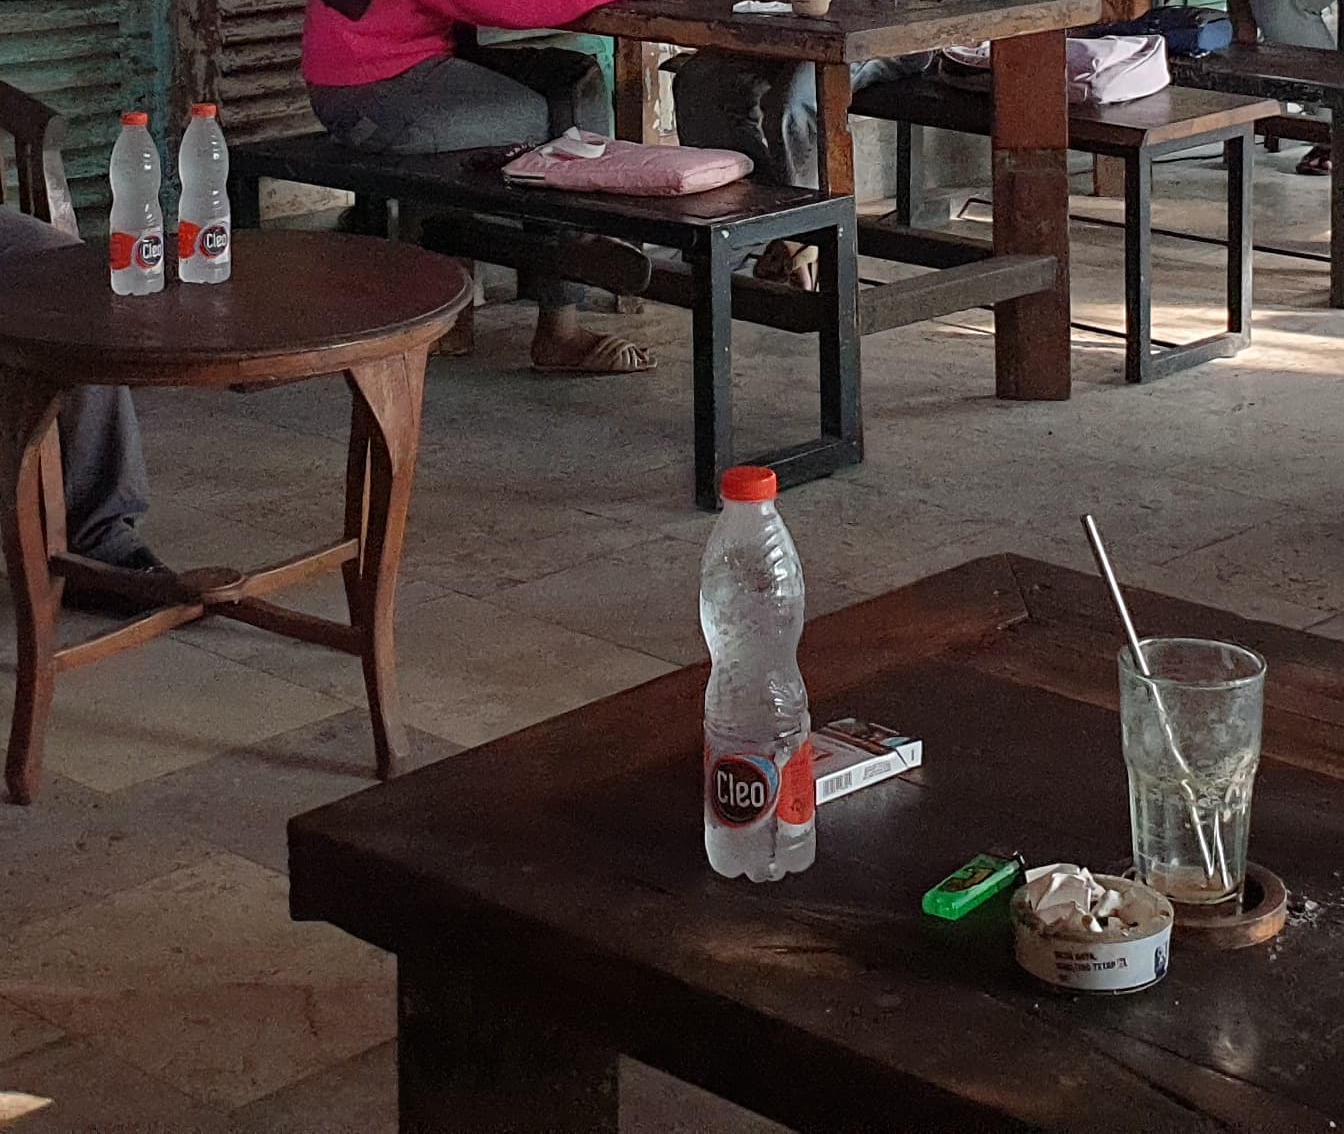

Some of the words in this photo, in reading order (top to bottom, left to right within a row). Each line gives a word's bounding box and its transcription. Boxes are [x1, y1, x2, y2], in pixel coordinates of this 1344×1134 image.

[206, 233, 227, 249] Cleo
[142, 244, 162, 259] Cleo
[716, 770, 765, 809] Cleo
